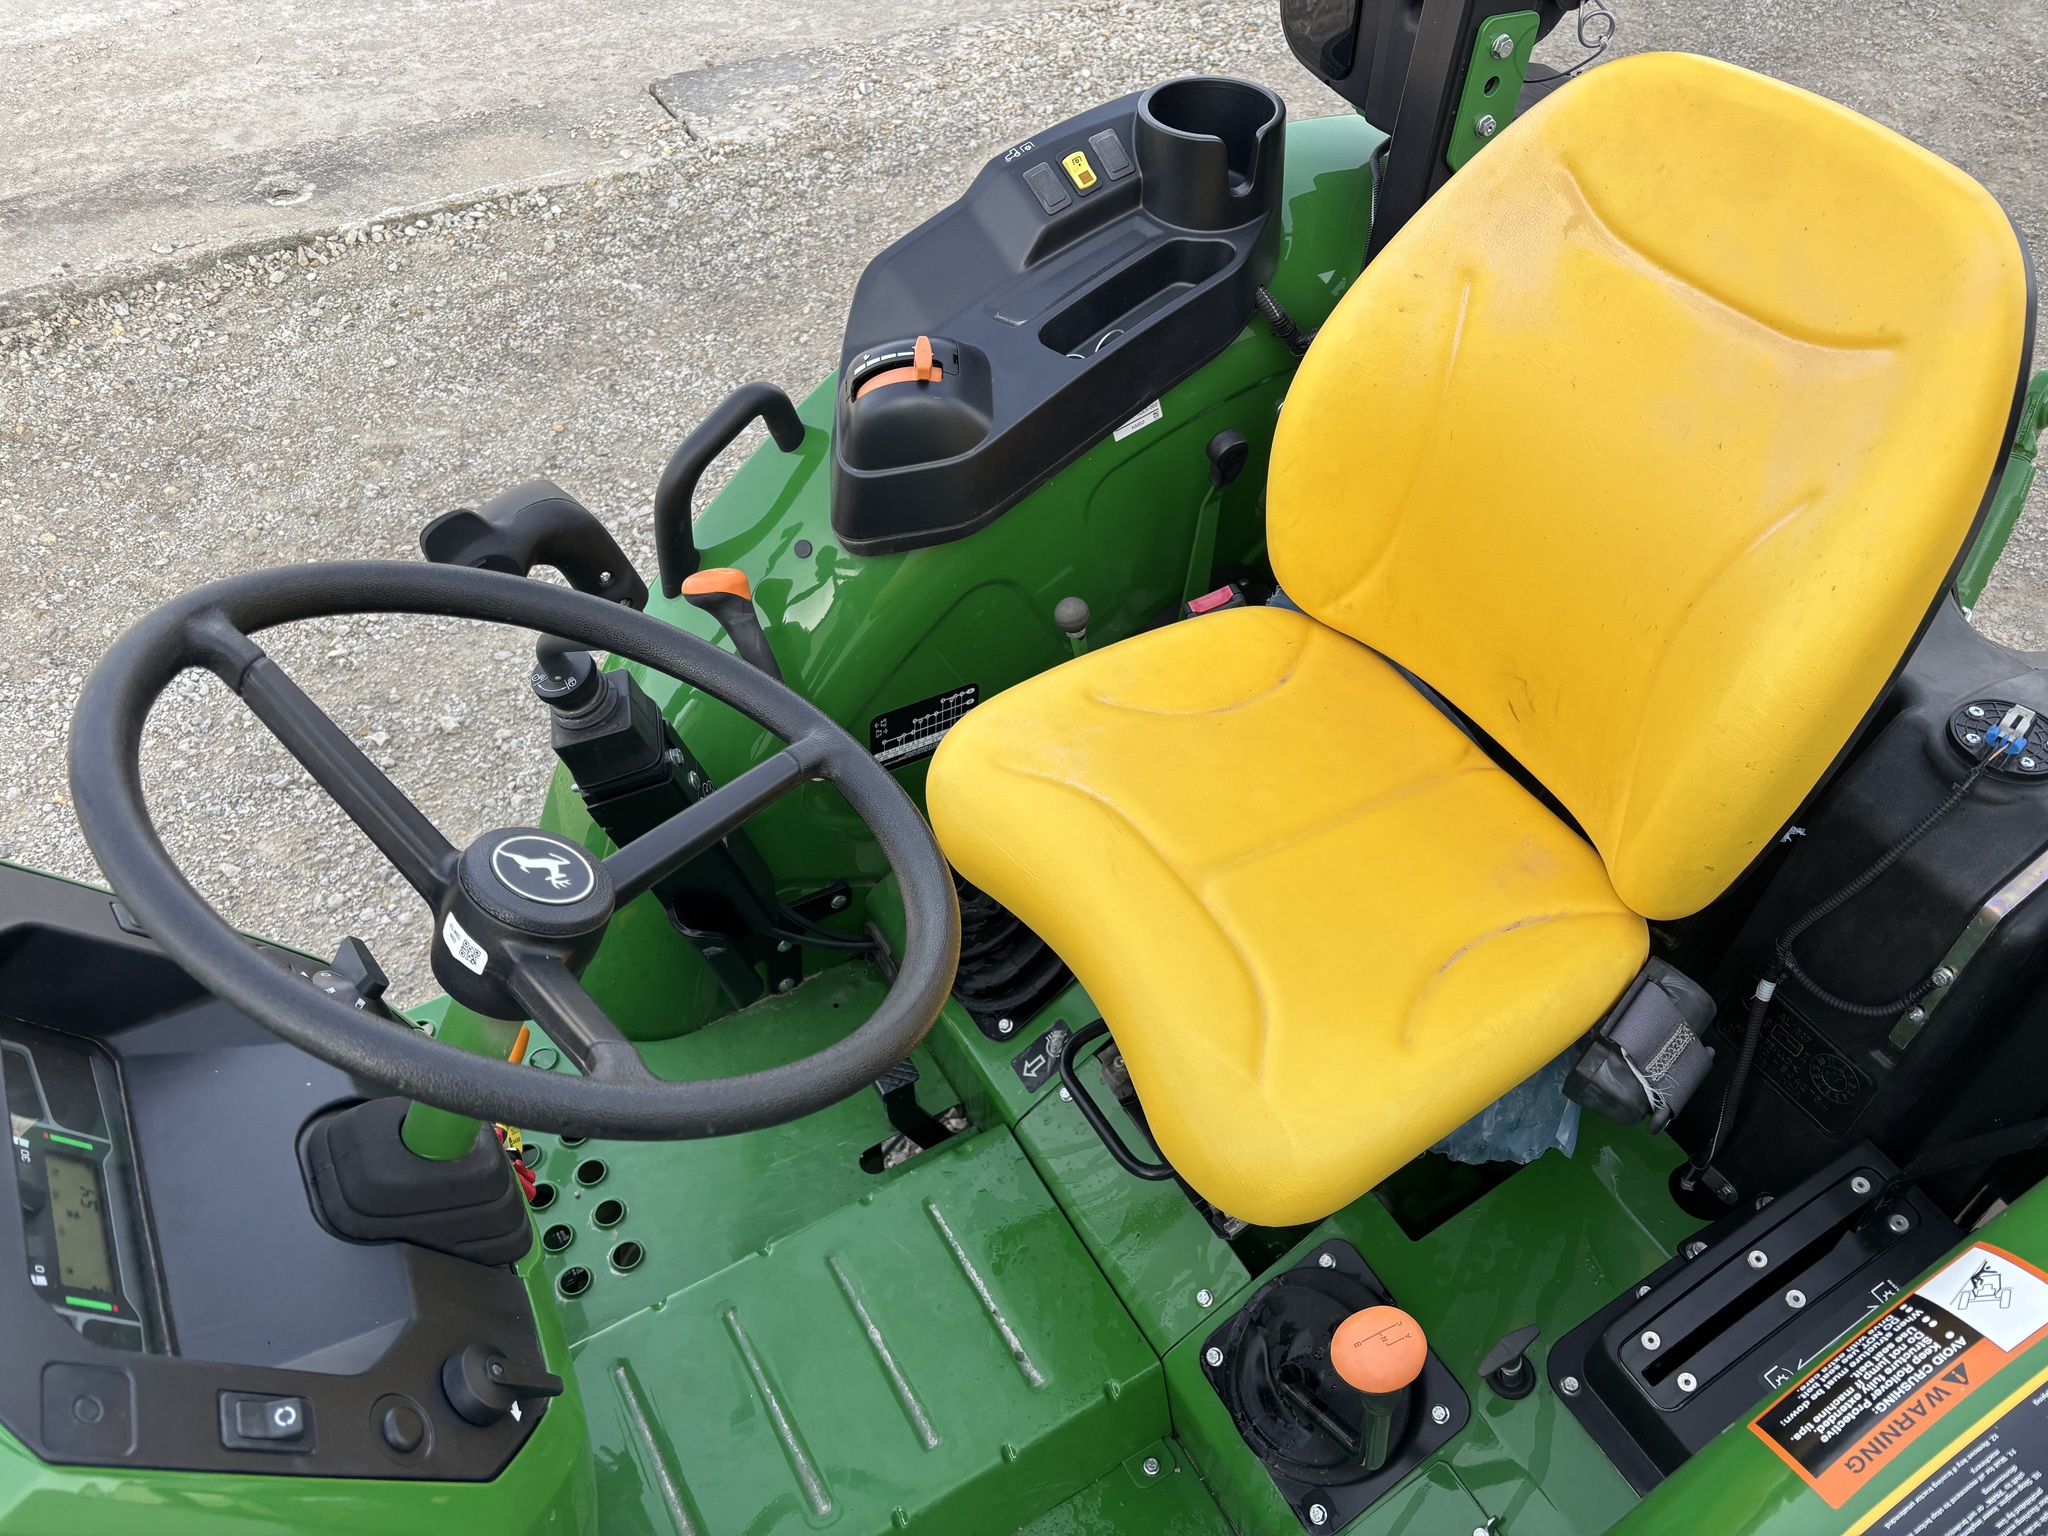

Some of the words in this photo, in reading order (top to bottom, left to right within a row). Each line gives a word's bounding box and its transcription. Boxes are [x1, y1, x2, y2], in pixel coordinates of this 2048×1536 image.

[20, 1148, 31, 1163] 30
[1863, 1314, 1895, 1341] Drive
[1882, 1317, 1901, 1331] DO
[1892, 1309, 1925, 1332] When
[1845, 1336, 1865, 1353] with
[1861, 1330, 1884, 1350] NOT
[1894, 1326, 1918, 1343] Use
[1906, 1330, 1926, 1344] Do
[1844, 1348, 1860, 1363] use
[1848, 1331, 1894, 1368] structure
[1871, 1342, 1896, 1362] seat
[1883, 1336, 1933, 1375] Structure
[1888, 1343, 1908, 1360] not
[1911, 1340, 1942, 1365] Keep
[1931, 1335, 1967, 1366] AVOID
[1820, 1352, 1846, 1373] extra
[1822, 1358, 1847, 1381] seat
[1849, 1360, 1875, 1379] belt.
[1860, 1356, 1892, 1380] jump
[1796, 1373, 1821, 1393] care.
[1797, 1377, 1826, 1400] belt.
[1823, 1367, 1850, 1390] must
[1854, 1379, 1865, 1389] if
[1861, 1373, 1886, 1395] fully
[1870, 1363, 1915, 1401] Rollover
[1871, 1363, 1934, 1415] CRUSHING:
[1810, 1388, 1826, 1401] be
[1812, 1386, 1858, 1424] machine
[1779, 1399, 1811, 1427] down:
[1813, 1392, 1866, 1435] extended.
[1820, 1398, 1873, 1443] Protective
[1790, 1422, 1815, 1441] tips.
[1844, 1378, 1952, 1474] WARNING
[1966, 1439, 1991, 1460] Remove
[1969, 1448, 2001, 1475] machinery.
